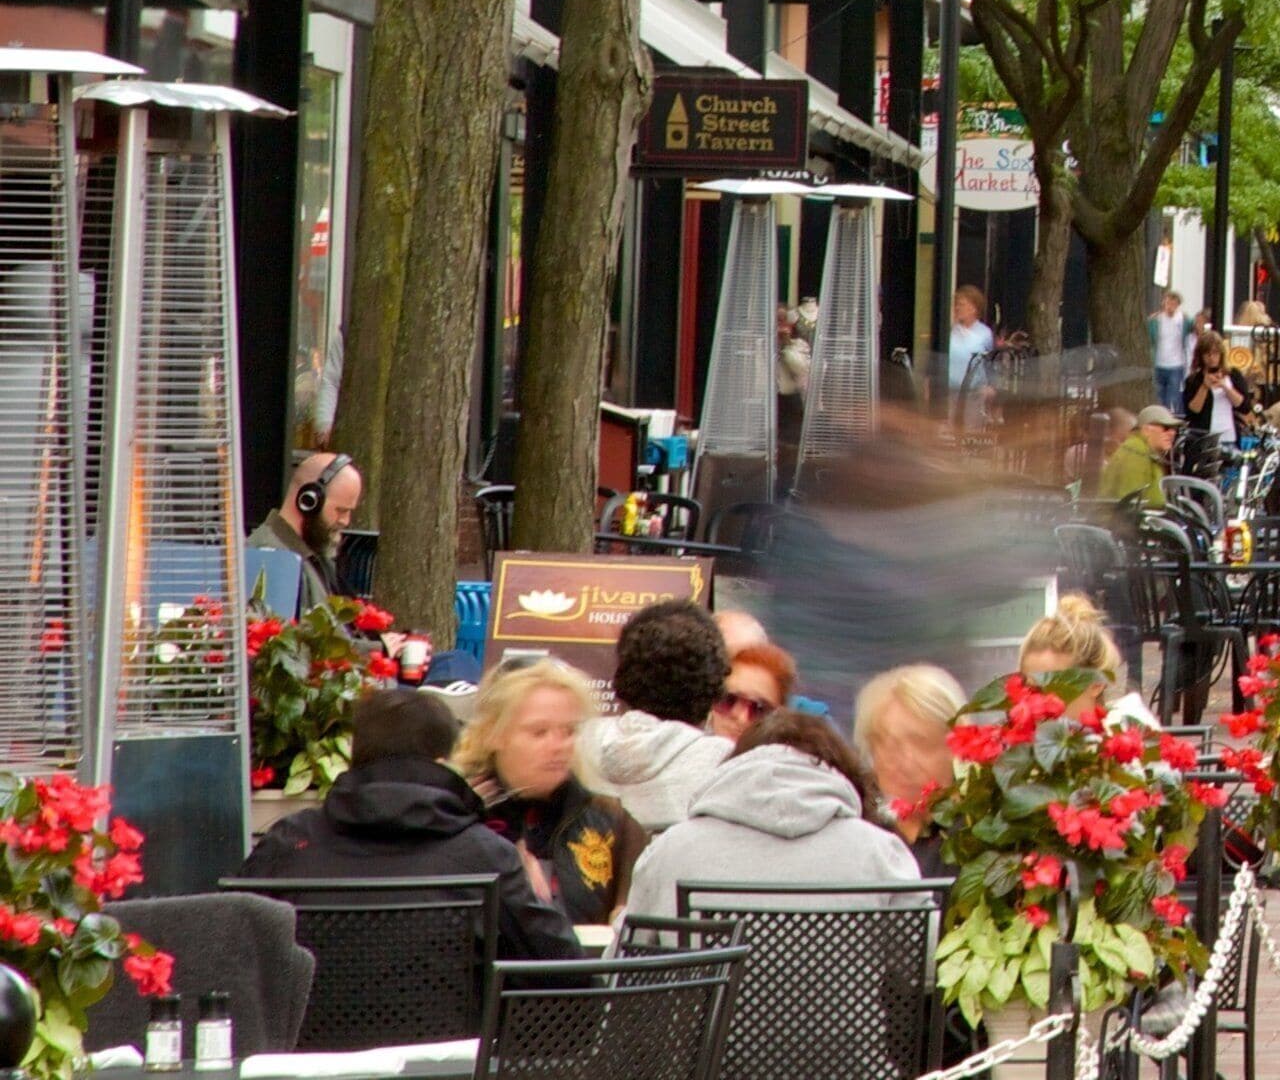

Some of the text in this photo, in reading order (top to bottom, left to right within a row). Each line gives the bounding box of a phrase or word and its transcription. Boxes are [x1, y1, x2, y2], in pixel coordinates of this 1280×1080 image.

[695, 95, 777, 114] Church
[703, 114, 771, 133] Street
[696, 133, 775, 151] Tavern
[588, 611, 634, 625] HOLIS
